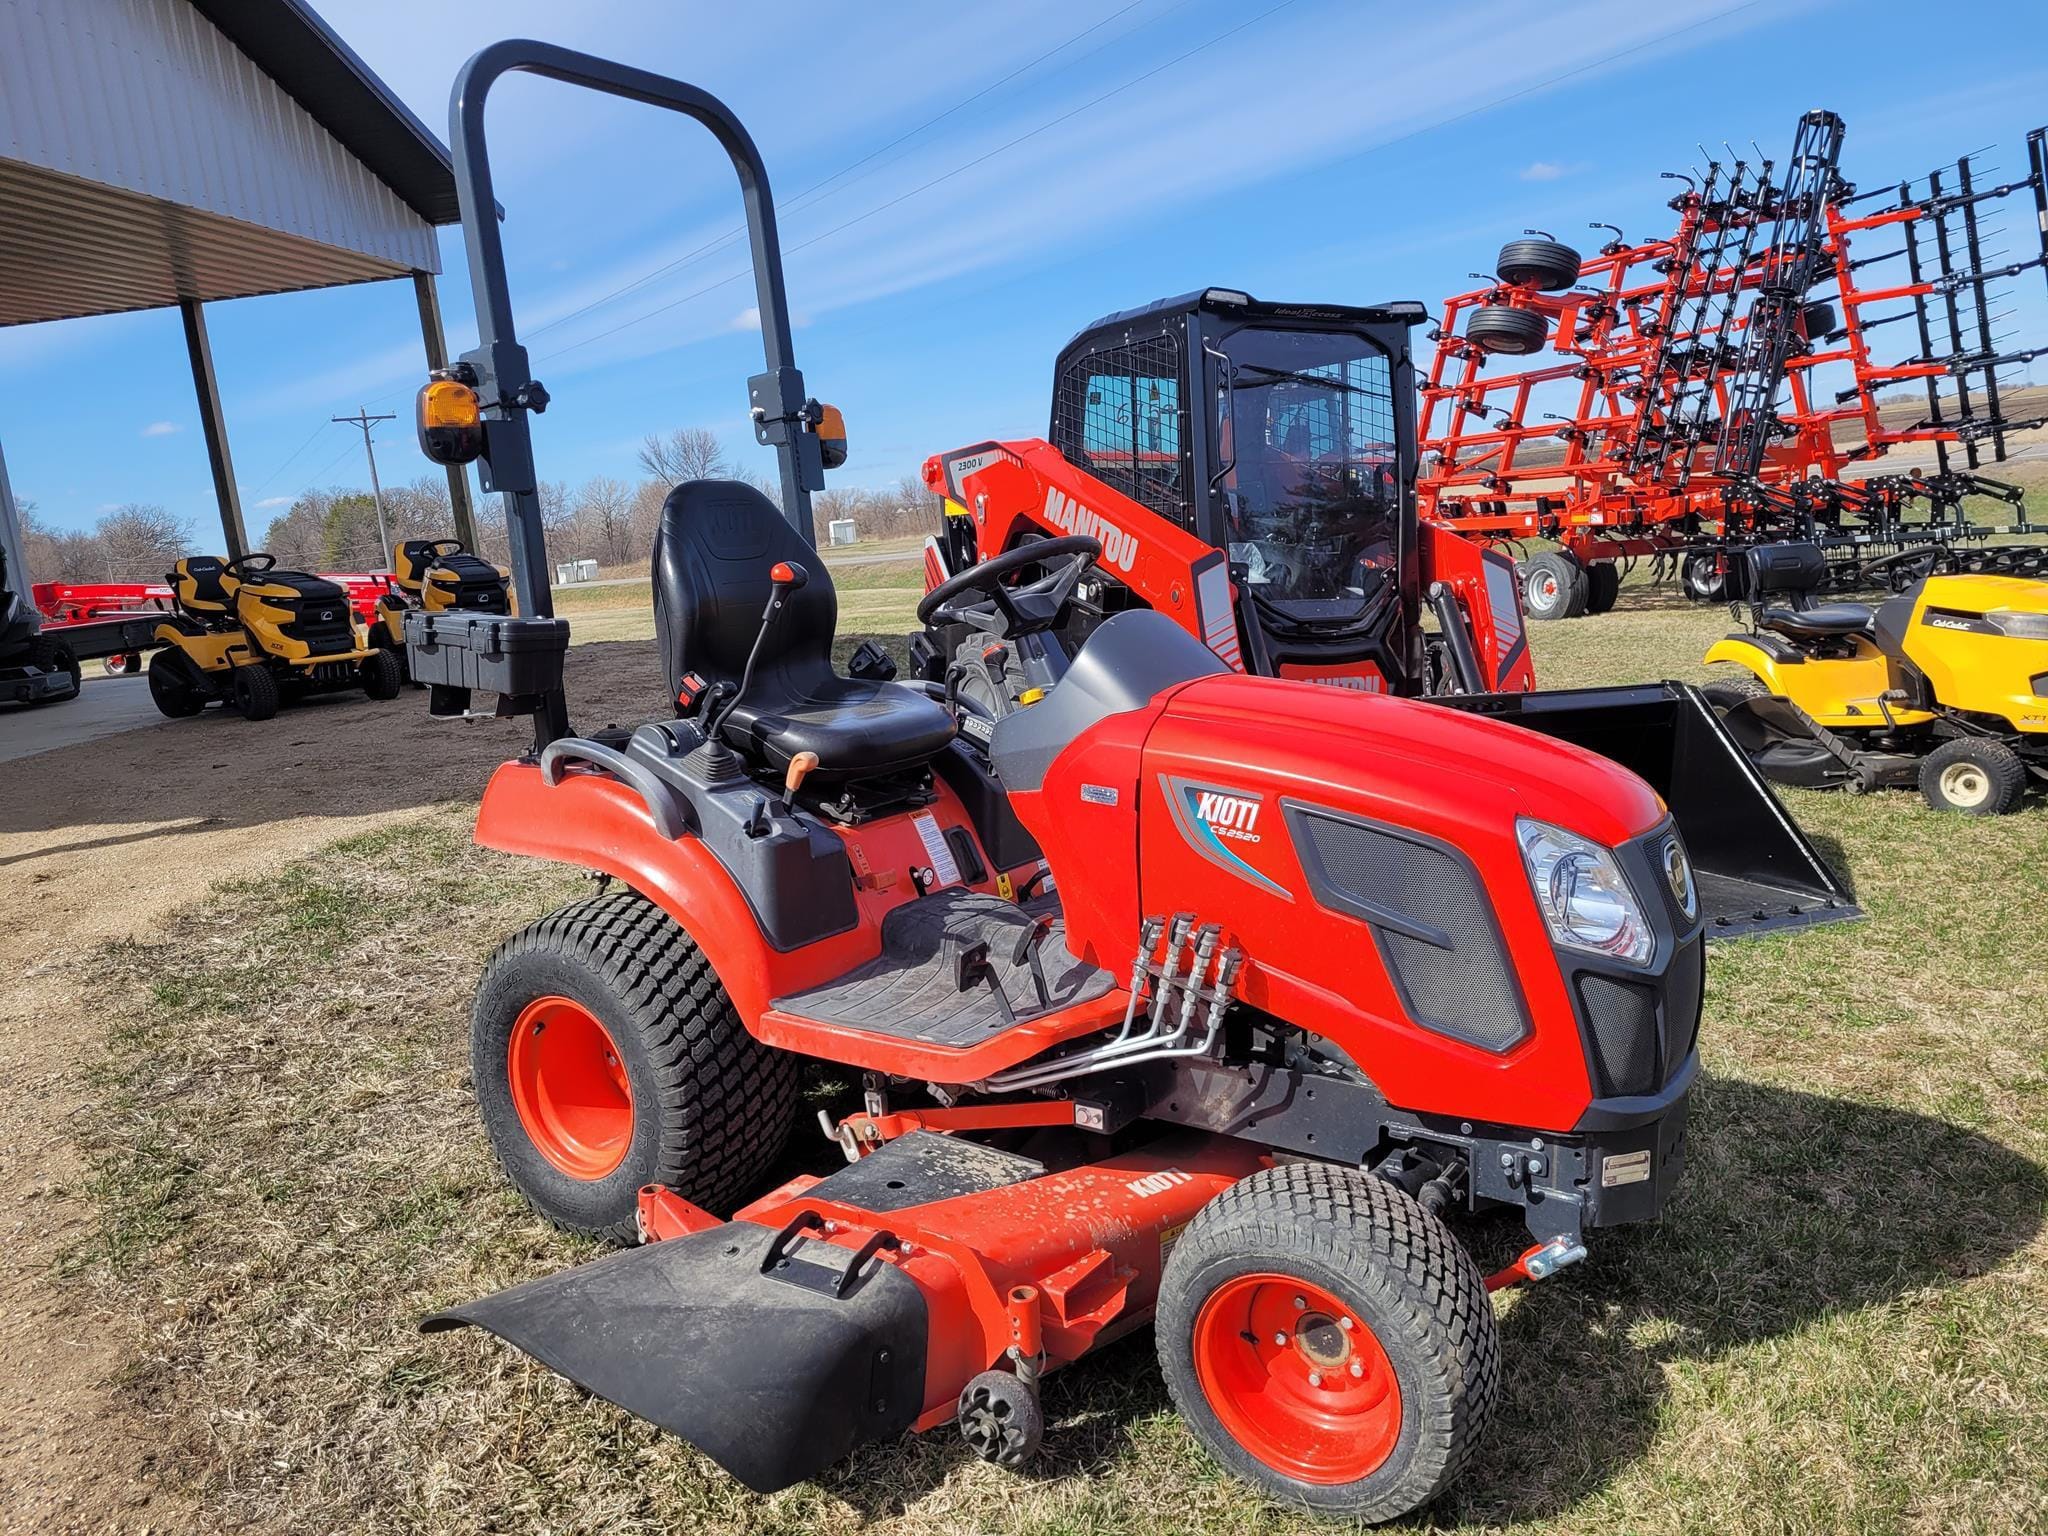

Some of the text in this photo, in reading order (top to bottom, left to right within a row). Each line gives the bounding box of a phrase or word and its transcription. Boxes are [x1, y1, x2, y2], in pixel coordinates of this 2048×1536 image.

[958, 456, 984, 472] 2300 V
[1042, 485, 1139, 573] MANITOU
[1197, 792, 1260, 831] KIOTI
[1210, 826, 1262, 843] CS2520
[1125, 1167, 1193, 1198] KIOTI
